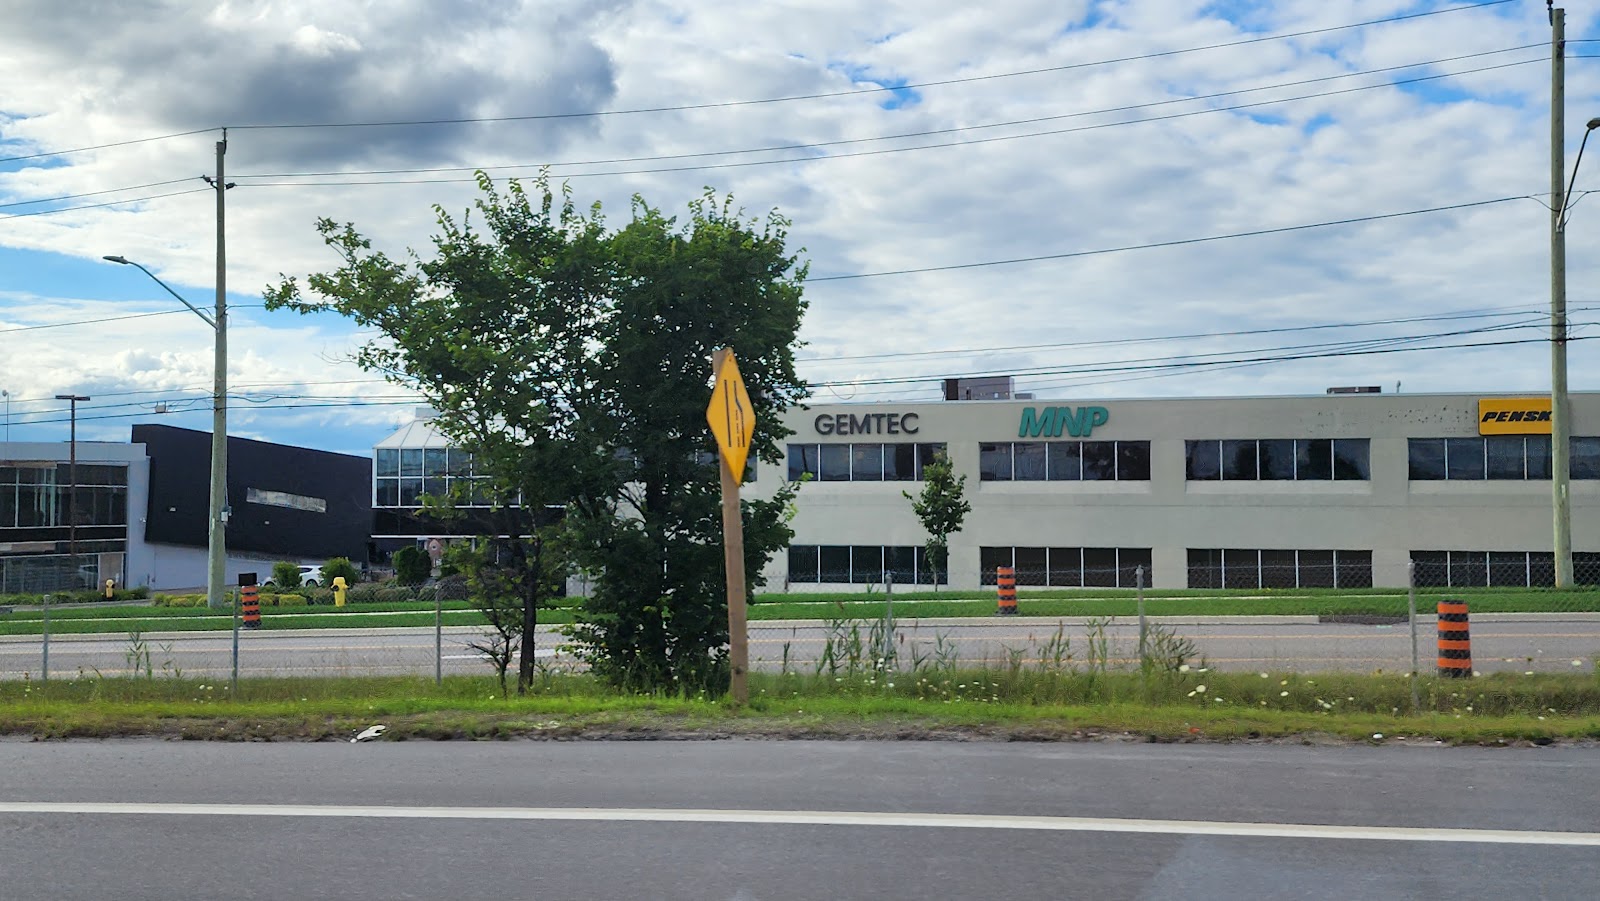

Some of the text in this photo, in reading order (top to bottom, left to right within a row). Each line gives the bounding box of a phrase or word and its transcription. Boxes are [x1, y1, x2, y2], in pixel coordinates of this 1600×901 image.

[814, 412, 919, 435] GEMTEC
[1018, 406, 1109, 438] MNP
[1482, 411, 1552, 422] PENSK
